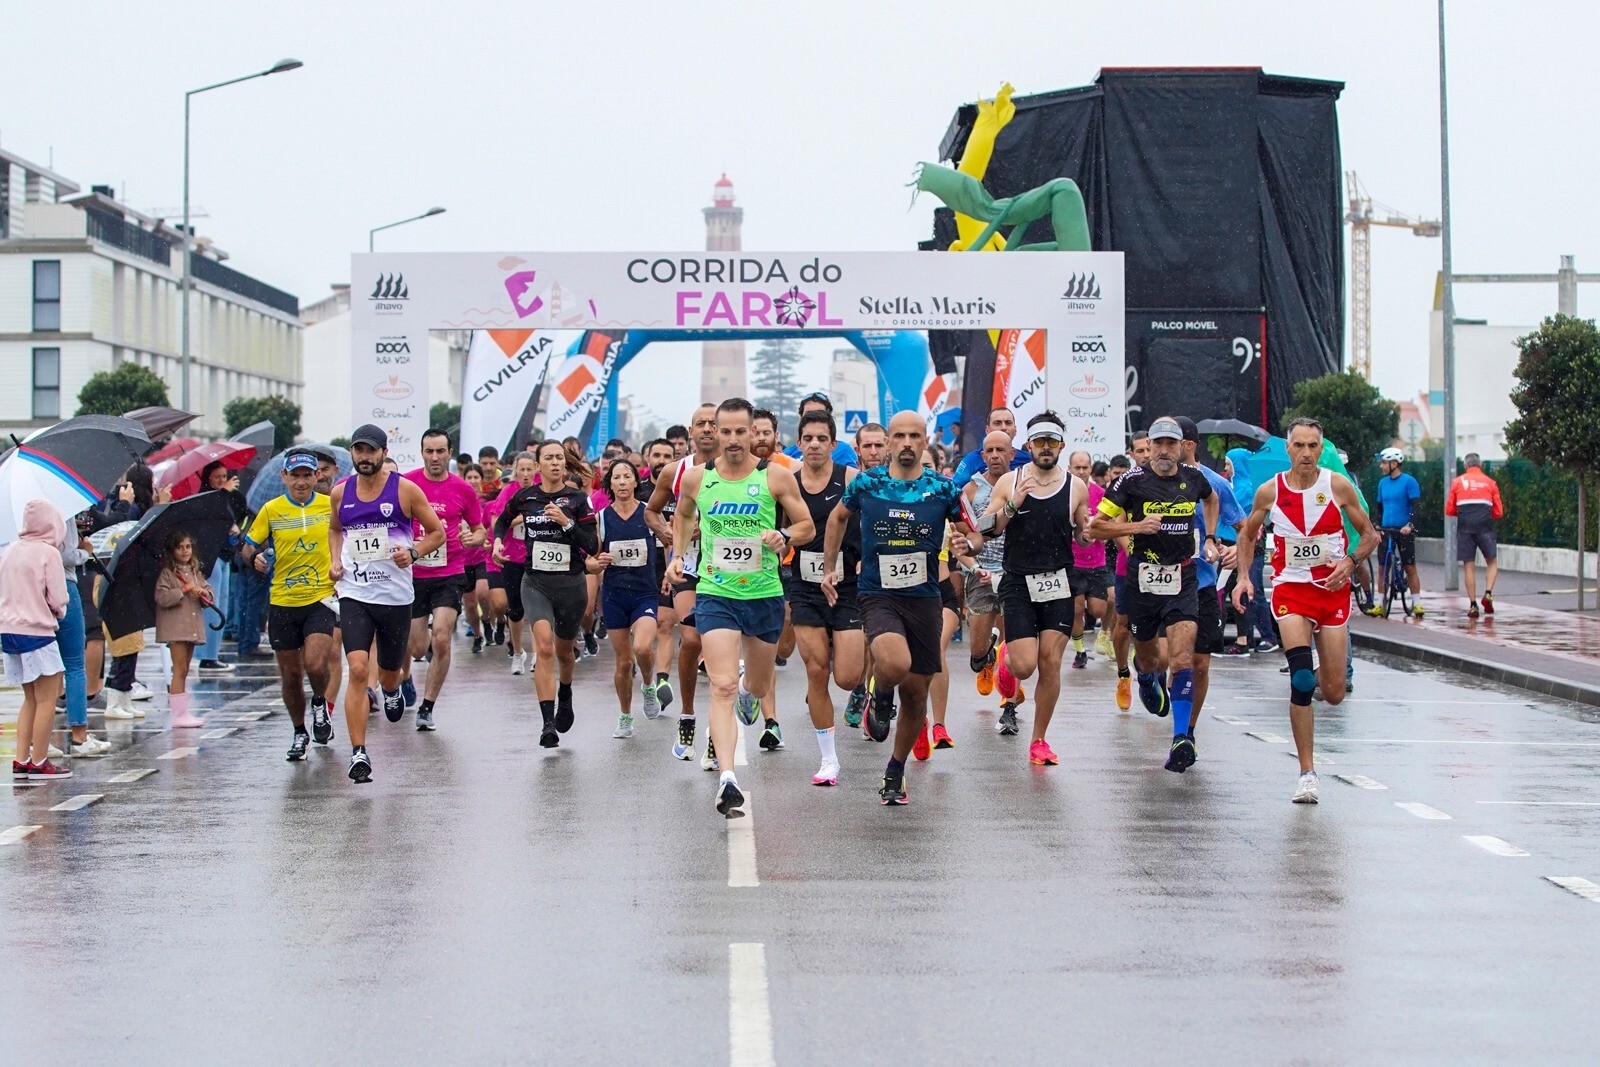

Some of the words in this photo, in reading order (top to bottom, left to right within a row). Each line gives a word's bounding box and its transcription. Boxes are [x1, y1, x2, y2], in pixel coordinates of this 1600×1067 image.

[627, 258, 789, 283] CORRIDA
[799, 257, 843, 283] do
[375, 302, 403, 310] ilhavo
[676, 291, 843, 326] FAROL
[859, 295, 923, 315] Stella
[930, 295, 996, 315] Maris
[1067, 302, 1095, 310] ilhavo
[1151, 321, 1183, 330] PALCO
[1185, 320, 1218, 330] MÓVEL
[376, 342, 411, 353] DOCA
[1072, 341, 1107, 353] DOCA
[1072, 355, 1088, 363] PURA
[1090, 355, 1106, 363] VIDA
[473, 337, 554, 402] CIVILRIA
[589, 340, 622, 412] CIVILRIA
[1013, 376, 1046, 409] CIVIL
[550, 392, 594, 431] CIVILRIA
[388, 435, 410, 443] alto
[1074, 434, 1106, 443] rialto
[708, 500, 760, 515] jmm
[723, 520, 761, 528] PREVENT
[1160, 522, 1189, 531] axima
[355, 538, 380, 551] 114
[540, 550, 563, 562] 290
[618, 548, 640, 558] 181
[723, 547, 753, 560] 299
[1293, 544, 1321, 558] 280
[889, 562, 918, 577] 342
[1146, 572, 1172, 583] 340
[1036, 578, 1061, 592] 294
